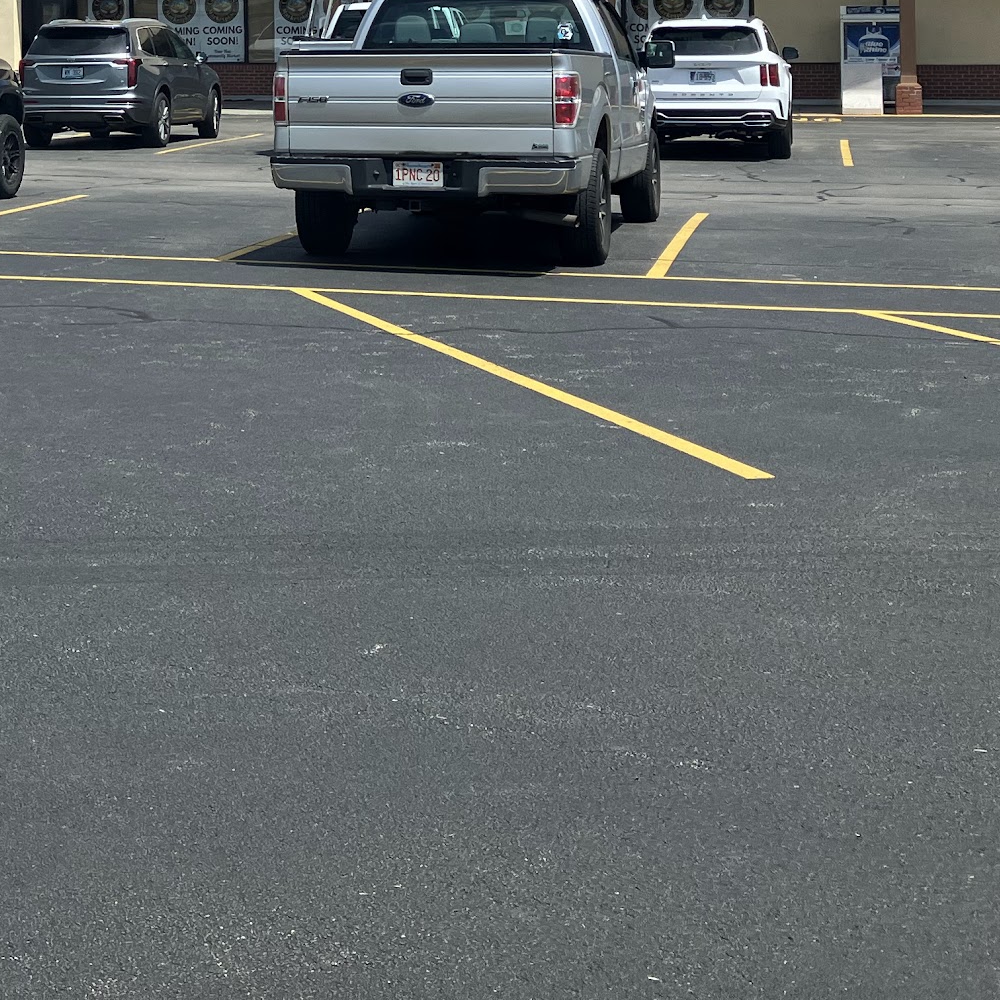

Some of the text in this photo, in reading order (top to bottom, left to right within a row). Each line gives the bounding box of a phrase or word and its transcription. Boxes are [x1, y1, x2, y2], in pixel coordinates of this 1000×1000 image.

[175, 26, 200, 35] MING
[203, 26, 243, 34] COMING
[207, 37, 239, 45] SOON!
[405, 95, 426, 105] Ford
[395, 168, 440, 181] 1PNC 20
